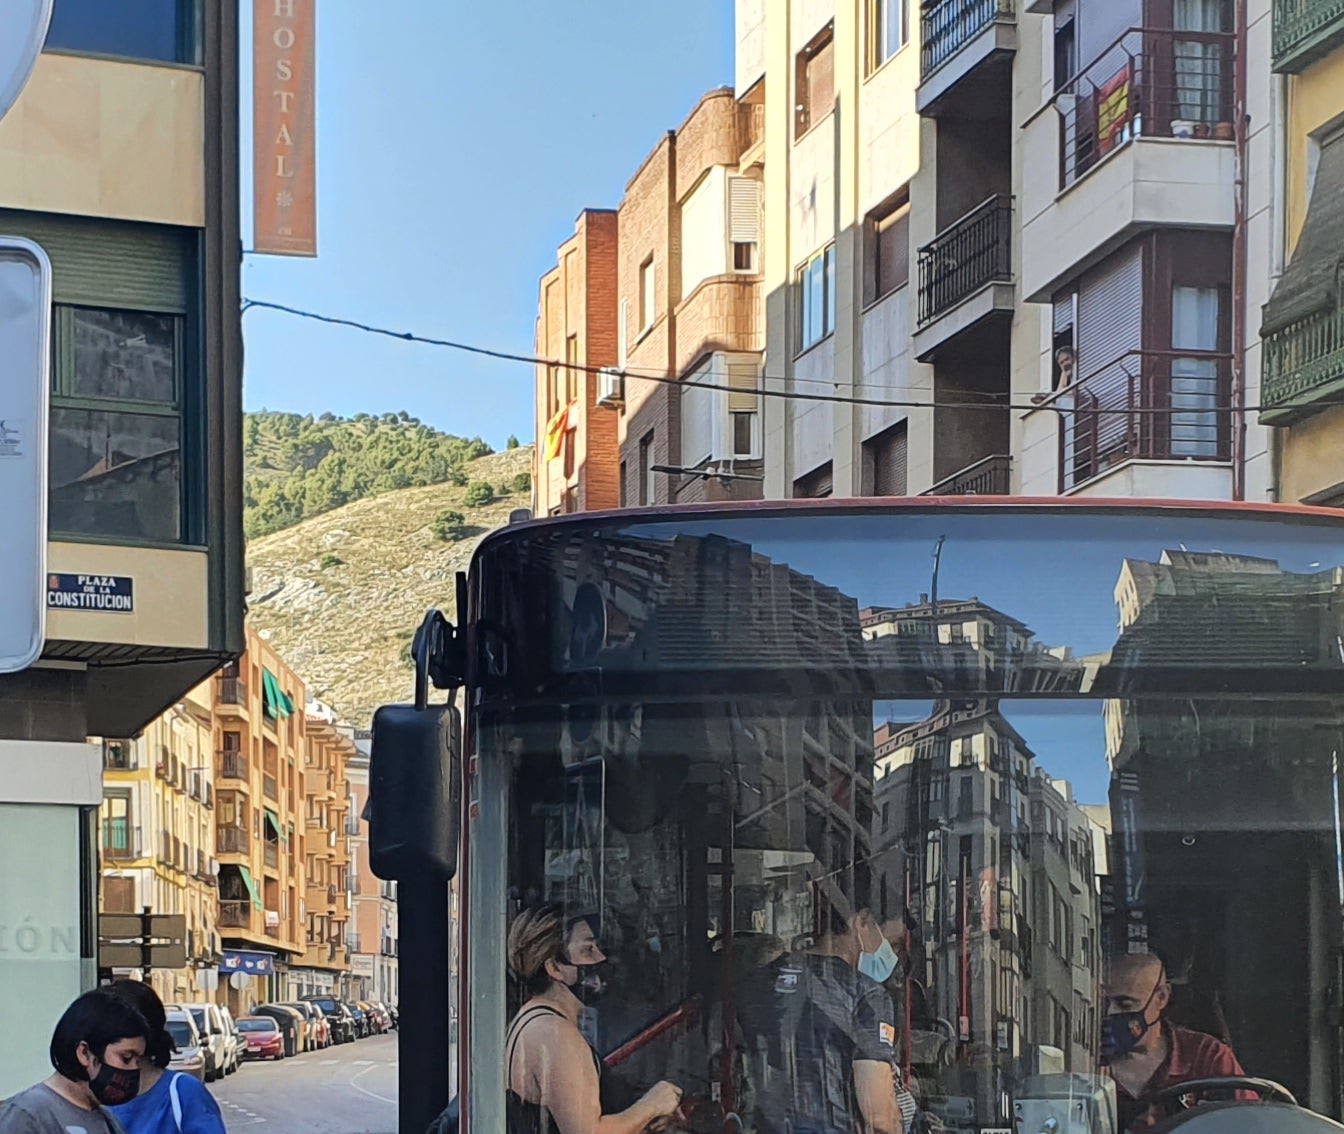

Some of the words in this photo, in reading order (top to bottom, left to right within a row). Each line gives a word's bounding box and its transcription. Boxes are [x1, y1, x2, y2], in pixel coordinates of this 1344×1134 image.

[273, 0, 295, 178] HOSTAL
[77, 575, 116, 587] PLAZA
[99, 586, 111, 594] LA
[47, 591, 131, 609] CONSTITUCION
